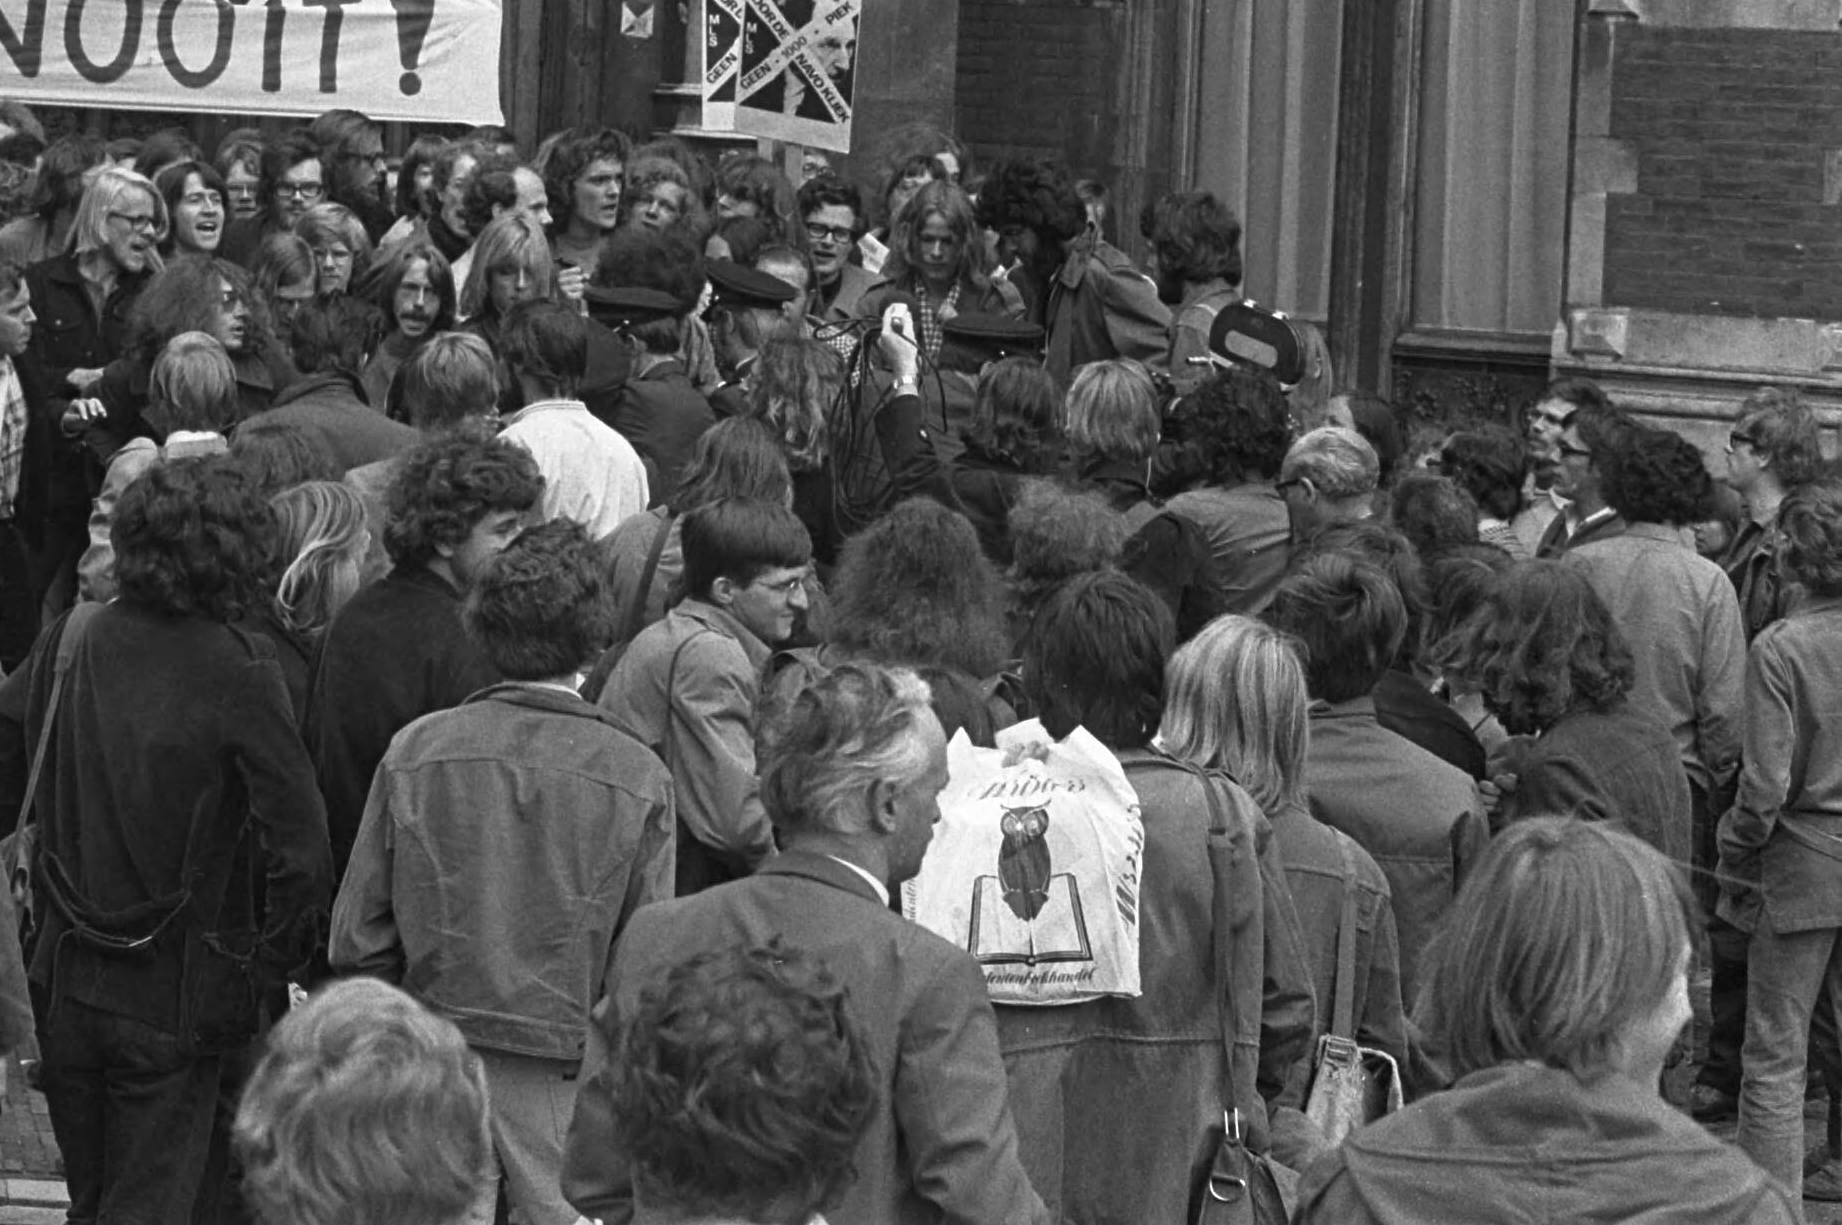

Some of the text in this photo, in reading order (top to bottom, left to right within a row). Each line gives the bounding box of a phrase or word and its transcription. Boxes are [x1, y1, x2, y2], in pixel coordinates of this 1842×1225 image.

[707, 52, 738, 84] GEEN
[740, 1, 854, 90] GEEN 1000 PIEK
[773, 22, 790, 40] DE
[796, 53, 825, 89] NAVO
